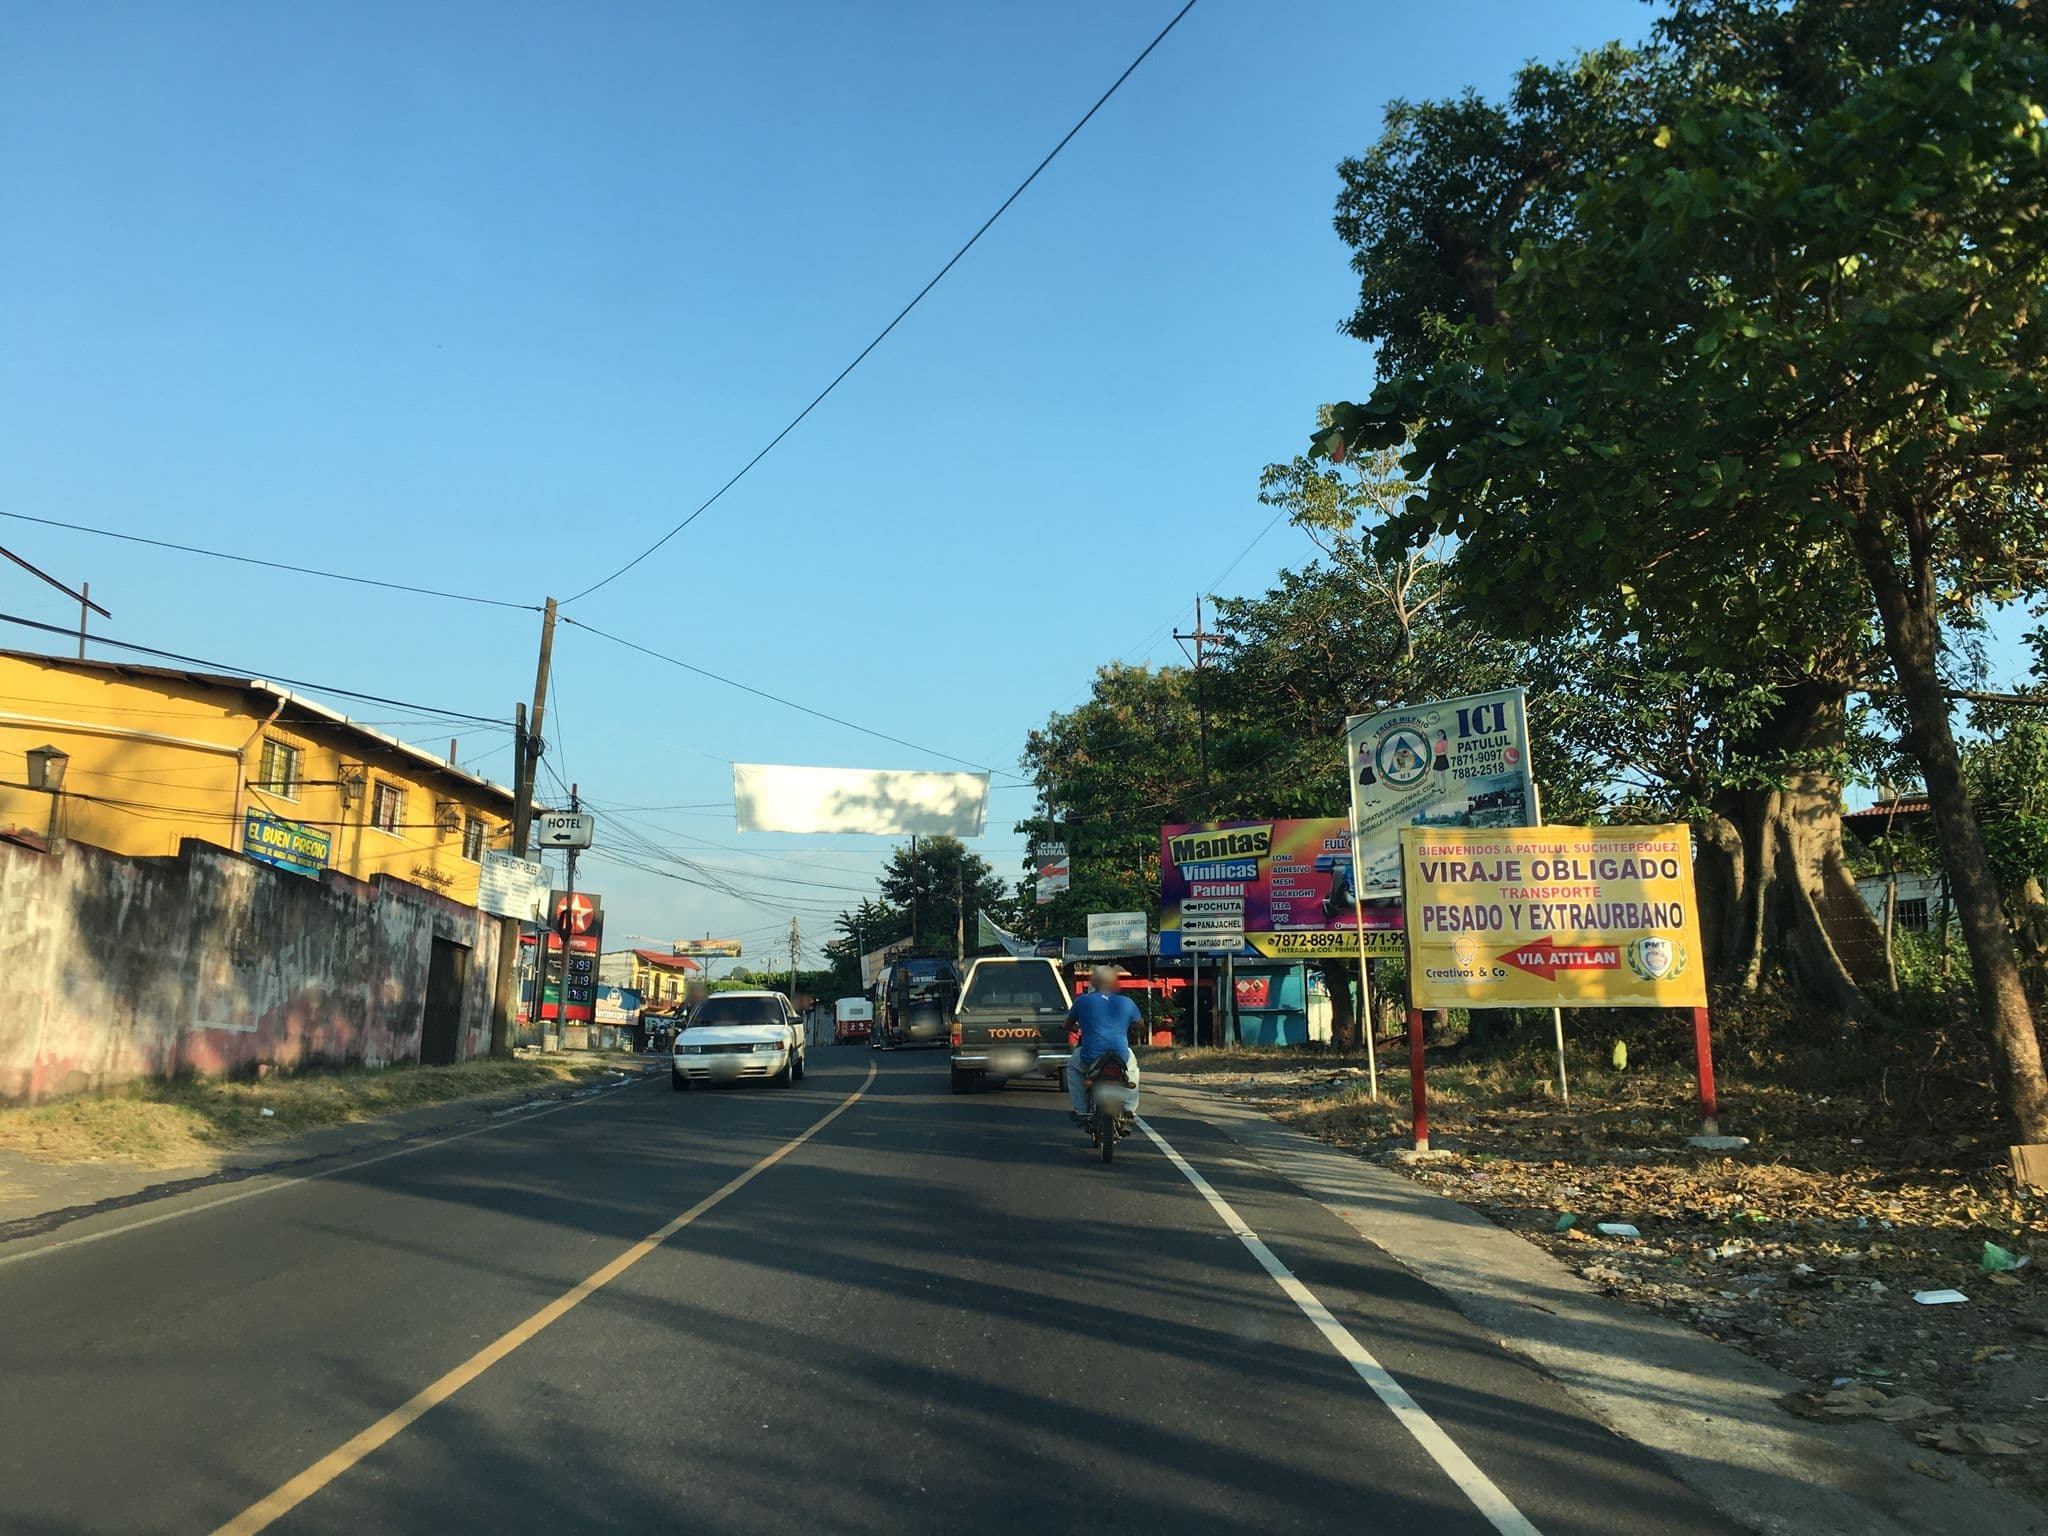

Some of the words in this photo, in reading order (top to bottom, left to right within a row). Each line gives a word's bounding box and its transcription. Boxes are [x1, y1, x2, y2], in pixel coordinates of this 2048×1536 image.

[1456, 702, 1507, 738] ICI
[1457, 735, 1511, 753] PATULUL
[1450, 749, 1502, 767] 7871-9097
[1451, 762, 1505, 780] 7882-2518
[547, 818, 581, 829] HOTEL
[248, 822, 260, 841] EL
[262, 826, 291, 849] BUEN
[292, 834, 328, 859] PRECIO
[1172, 829, 1270, 863] Mantas
[1324, 839, 1345, 850] FULL
[1418, 845, 1501, 856] BIENVENIDOS
[1504, 845, 1513, 855] A
[1516, 844, 1568, 855] PATULUL
[1272, 854, 1294, 862] LONA
[1272, 865, 1311, 874] ADHESIVO
[1419, 860, 1522, 883] VIRAJE
[1531, 858, 1679, 882] OBLIGADO
[1272, 878, 1295, 886] MESH
[1192, 883, 1245, 897] Patulul
[1272, 889, 1315, 898] BACKLIGHT
[1500, 886, 1601, 899] TRANSPORTE
[1422, 904, 1503, 932] PESADO
[1509, 904, 1522, 930] Y
[1530, 902, 1683, 930] EXTRAURBANO
[1198, 920, 1241, 929] PANAJACHEL
[1274, 933, 1344, 947] 7872-8894
[1644, 941, 1666, 949] PMT
[1516, 953, 1542, 966] VIA
[1549, 951, 1616, 965] ATITLAN
[1426, 967, 1474, 978] Creativos
[1478, 966, 1487, 977] &
[1492, 967, 1508, 977] Co.
[988, 1028, 1041, 1038] TOYOTA
